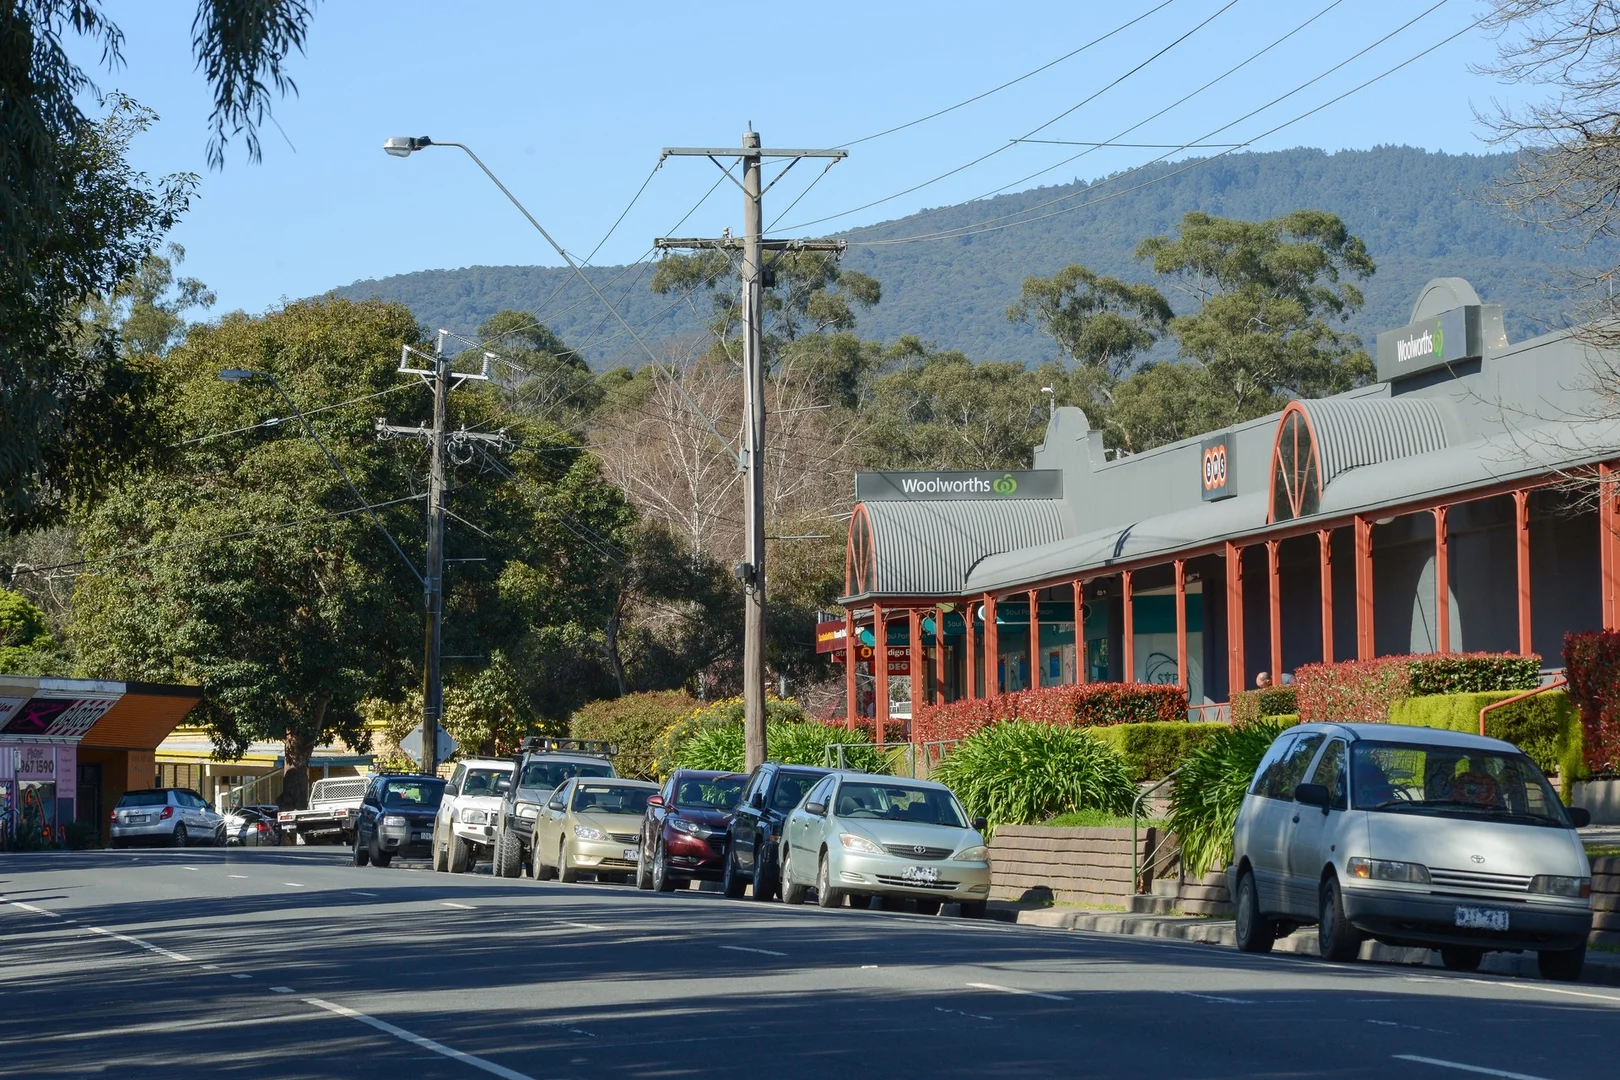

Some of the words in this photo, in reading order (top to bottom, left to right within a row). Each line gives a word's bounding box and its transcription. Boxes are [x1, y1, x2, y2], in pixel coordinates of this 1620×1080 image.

[1397, 330, 1433, 362] Woolworths
[901, 477, 990, 492] Woolworths
[1005, 608, 1020, 616] Soul
[947, 620, 962, 628] Soul
[888, 662, 908, 671] DEO
[27, 747, 44, 760] Phone
